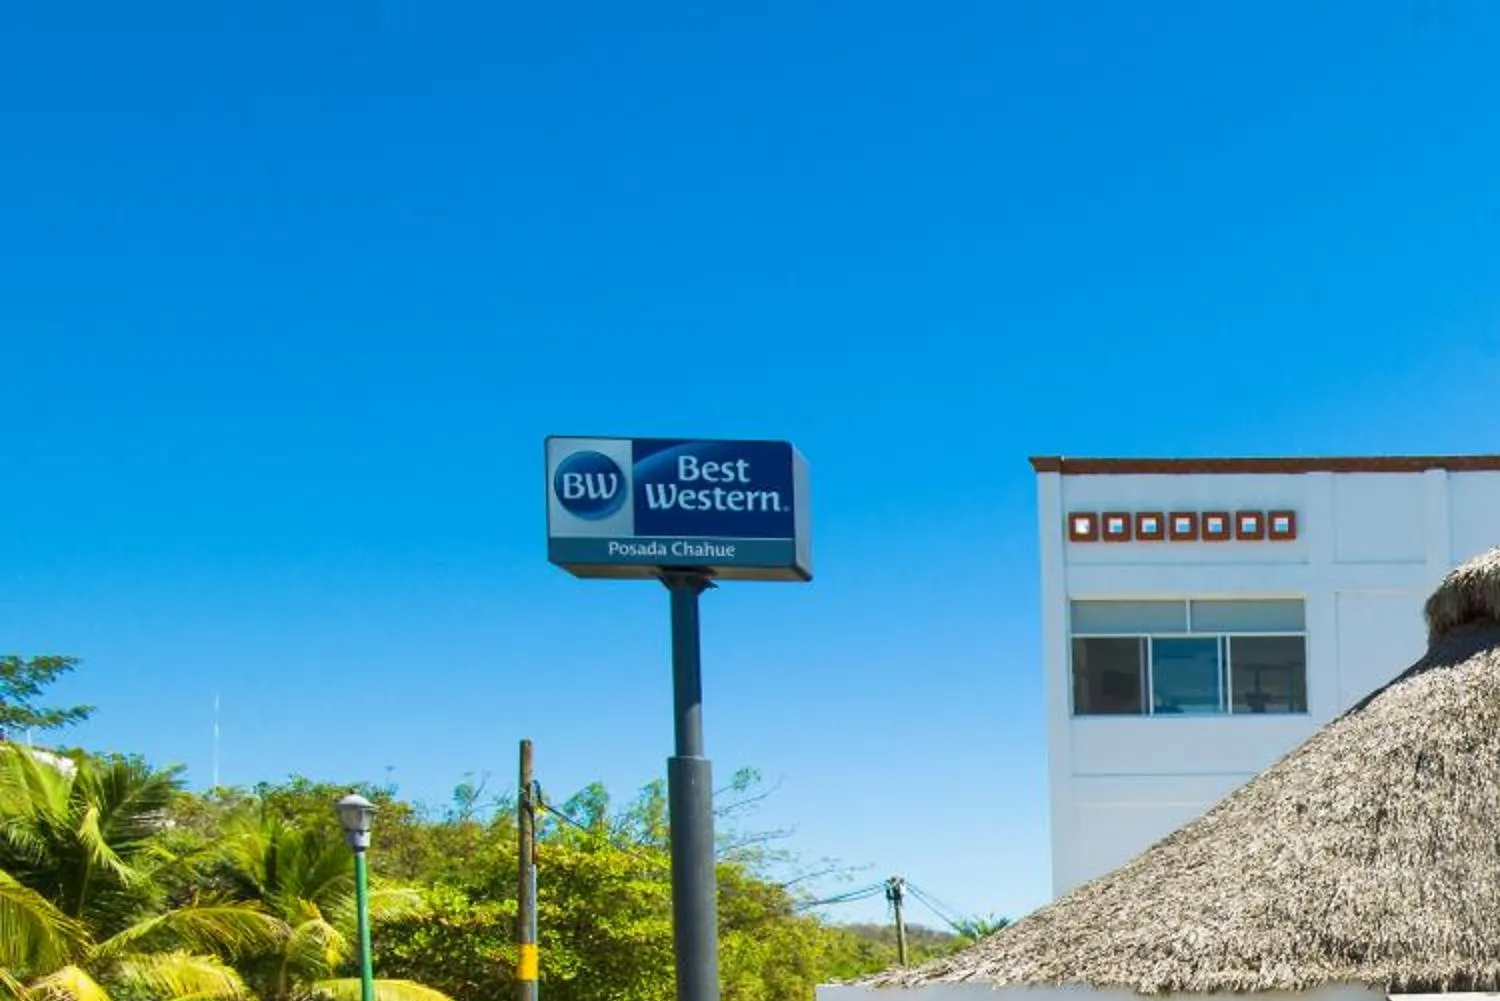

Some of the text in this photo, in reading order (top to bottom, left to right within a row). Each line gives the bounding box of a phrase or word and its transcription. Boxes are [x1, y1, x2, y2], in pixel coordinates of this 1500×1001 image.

[678, 455, 751, 482] Best
[563, 472, 617, 499] BW
[608, 541, 736, 557] Posada Chahue
